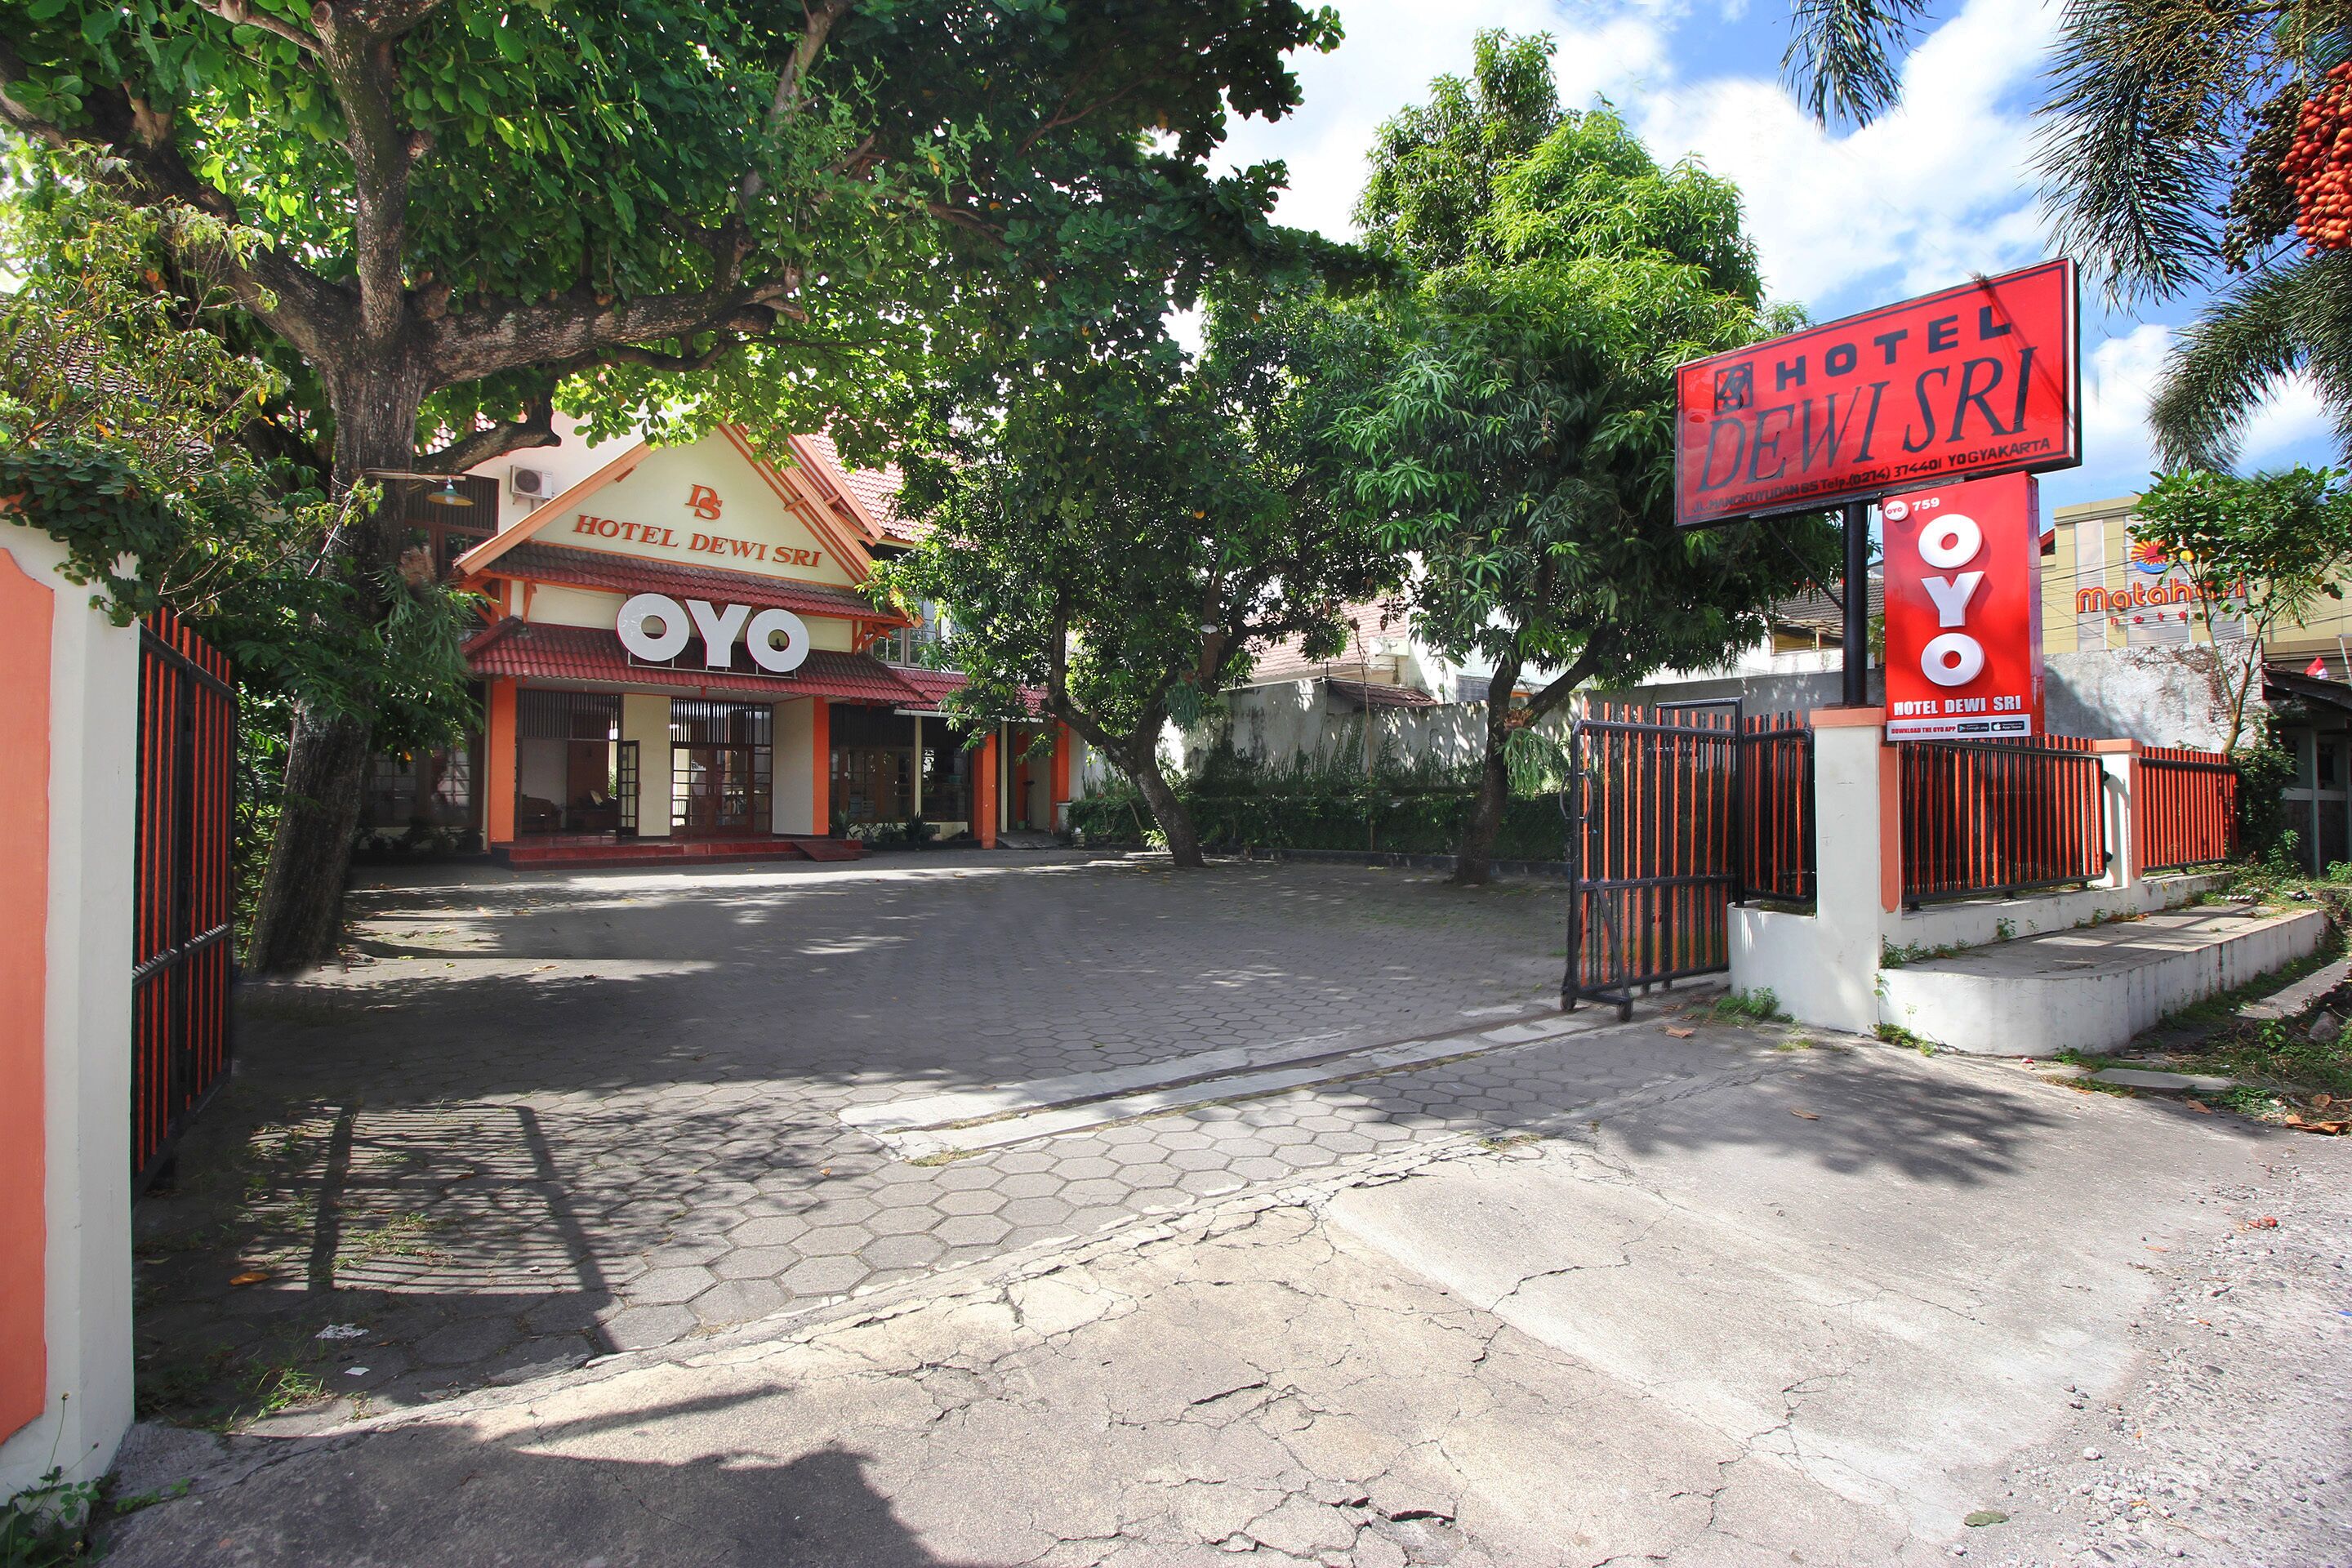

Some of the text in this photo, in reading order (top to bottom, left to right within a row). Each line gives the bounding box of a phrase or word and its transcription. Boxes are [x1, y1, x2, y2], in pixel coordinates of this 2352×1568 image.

[1775, 305, 2011, 392] HOTEL
[1695, 346, 2038, 493] DEWI SRI
[1894, 458, 1941, 478] 374401
[1948, 438, 2051, 468] YOGYAKARTA
[1886, 497, 1940, 515] OYO 759
[572, 514, 822, 568] HOTEL DEWI SRI
[1918, 514, 1985, 687] OYO
[2111, 612, 2198, 626] hote
[616, 593, 810, 673] OYO
[1893, 695, 2021, 716] HOTEL DEWI SRI
